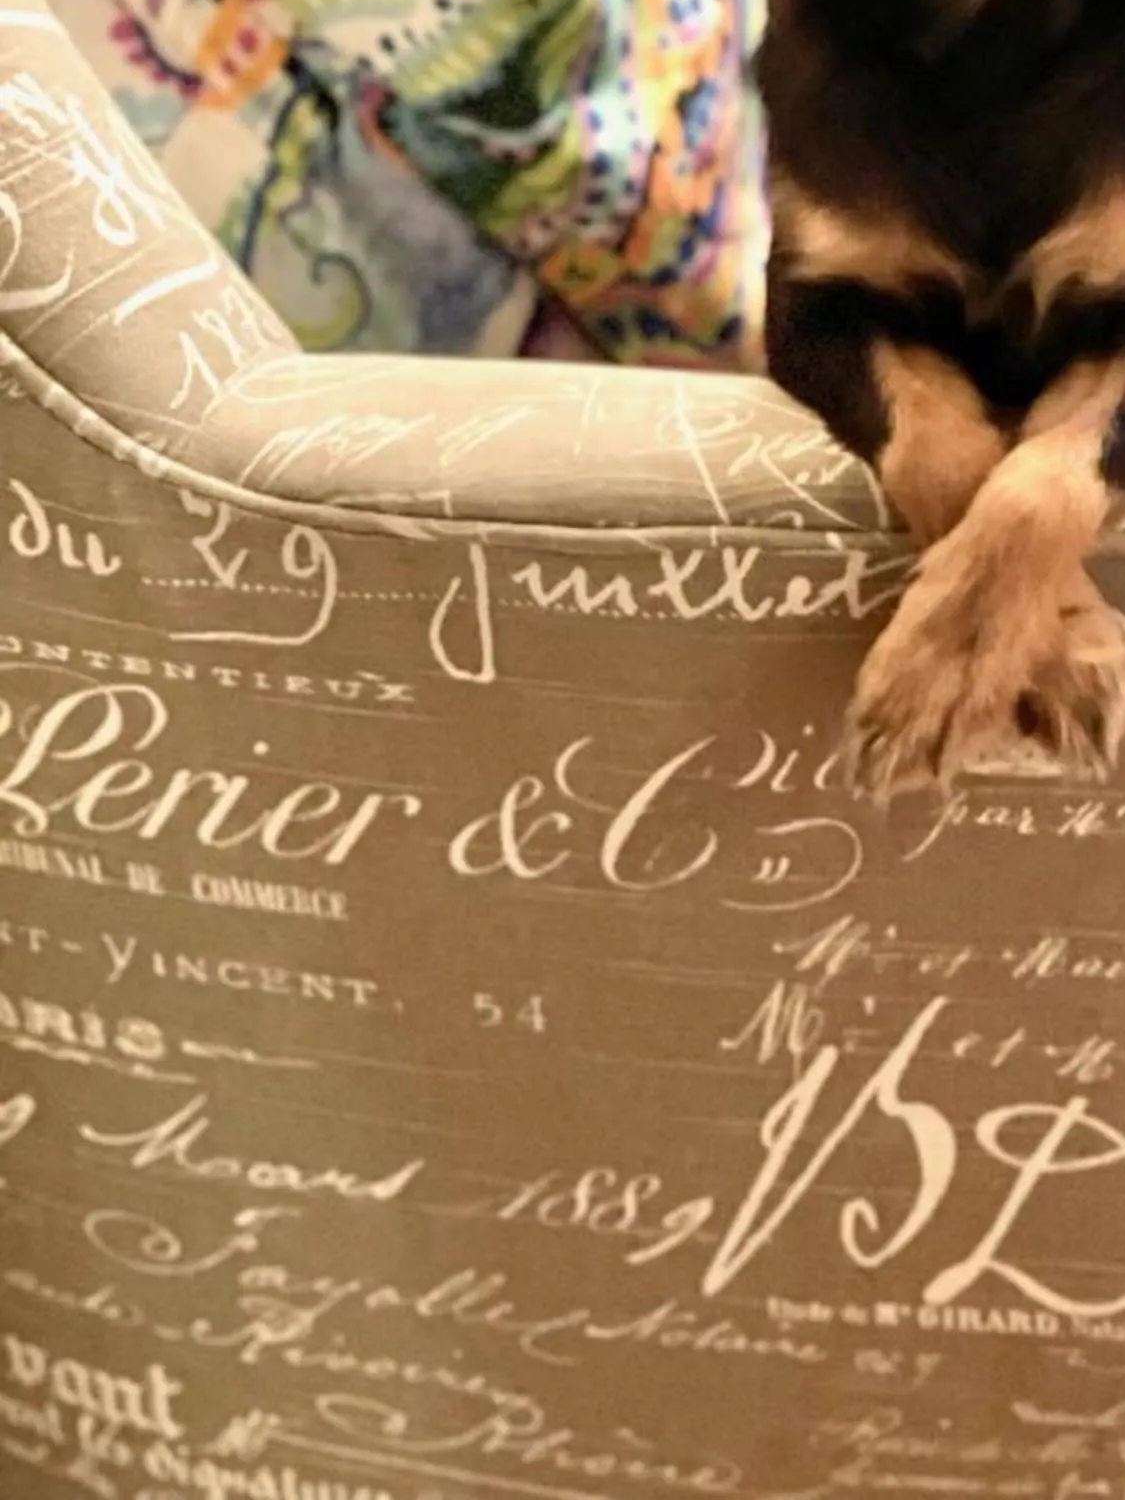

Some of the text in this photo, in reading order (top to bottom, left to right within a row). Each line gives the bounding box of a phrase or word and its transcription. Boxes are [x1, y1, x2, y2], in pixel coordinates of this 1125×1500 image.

[190, 872, 350, 922] COMMERCE
[471, 991, 547, 1034] 54
[916, 1306, 1062, 1338] GIRARD
